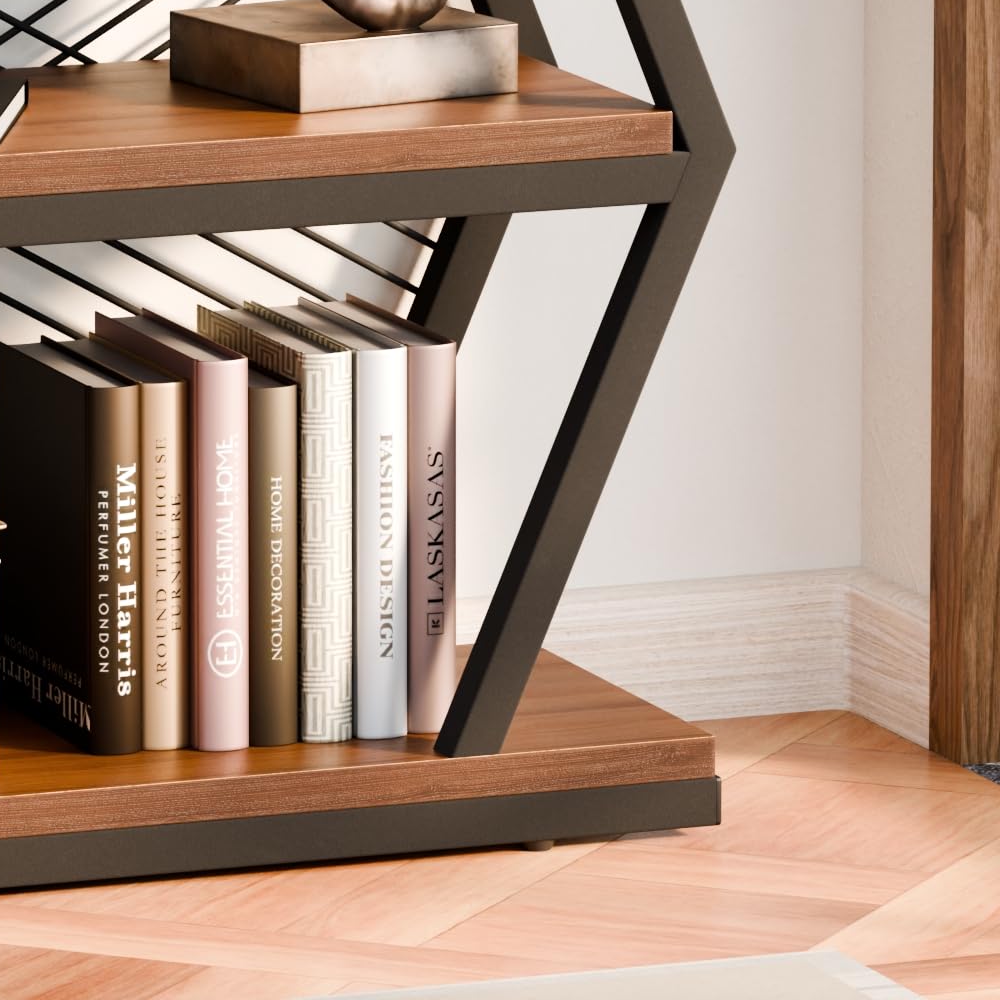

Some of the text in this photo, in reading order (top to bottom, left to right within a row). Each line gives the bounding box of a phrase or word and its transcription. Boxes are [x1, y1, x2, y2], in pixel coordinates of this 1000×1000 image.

[155, 437, 168, 689] AROUND THE HOUSE
[171, 493, 182, 632] FURNITURE
[215, 435, 234, 507] HOME
[379, 433, 395, 660] FASHION DESIGN
[97, 490, 110, 674] PERFUMER LONDON
[116, 462, 137, 697] Miller Harris
[215, 510, 234, 619] ESSENTIAL
[270, 476, 283, 662] HOME DECORATION
[46, 683, 92, 732] Miller
